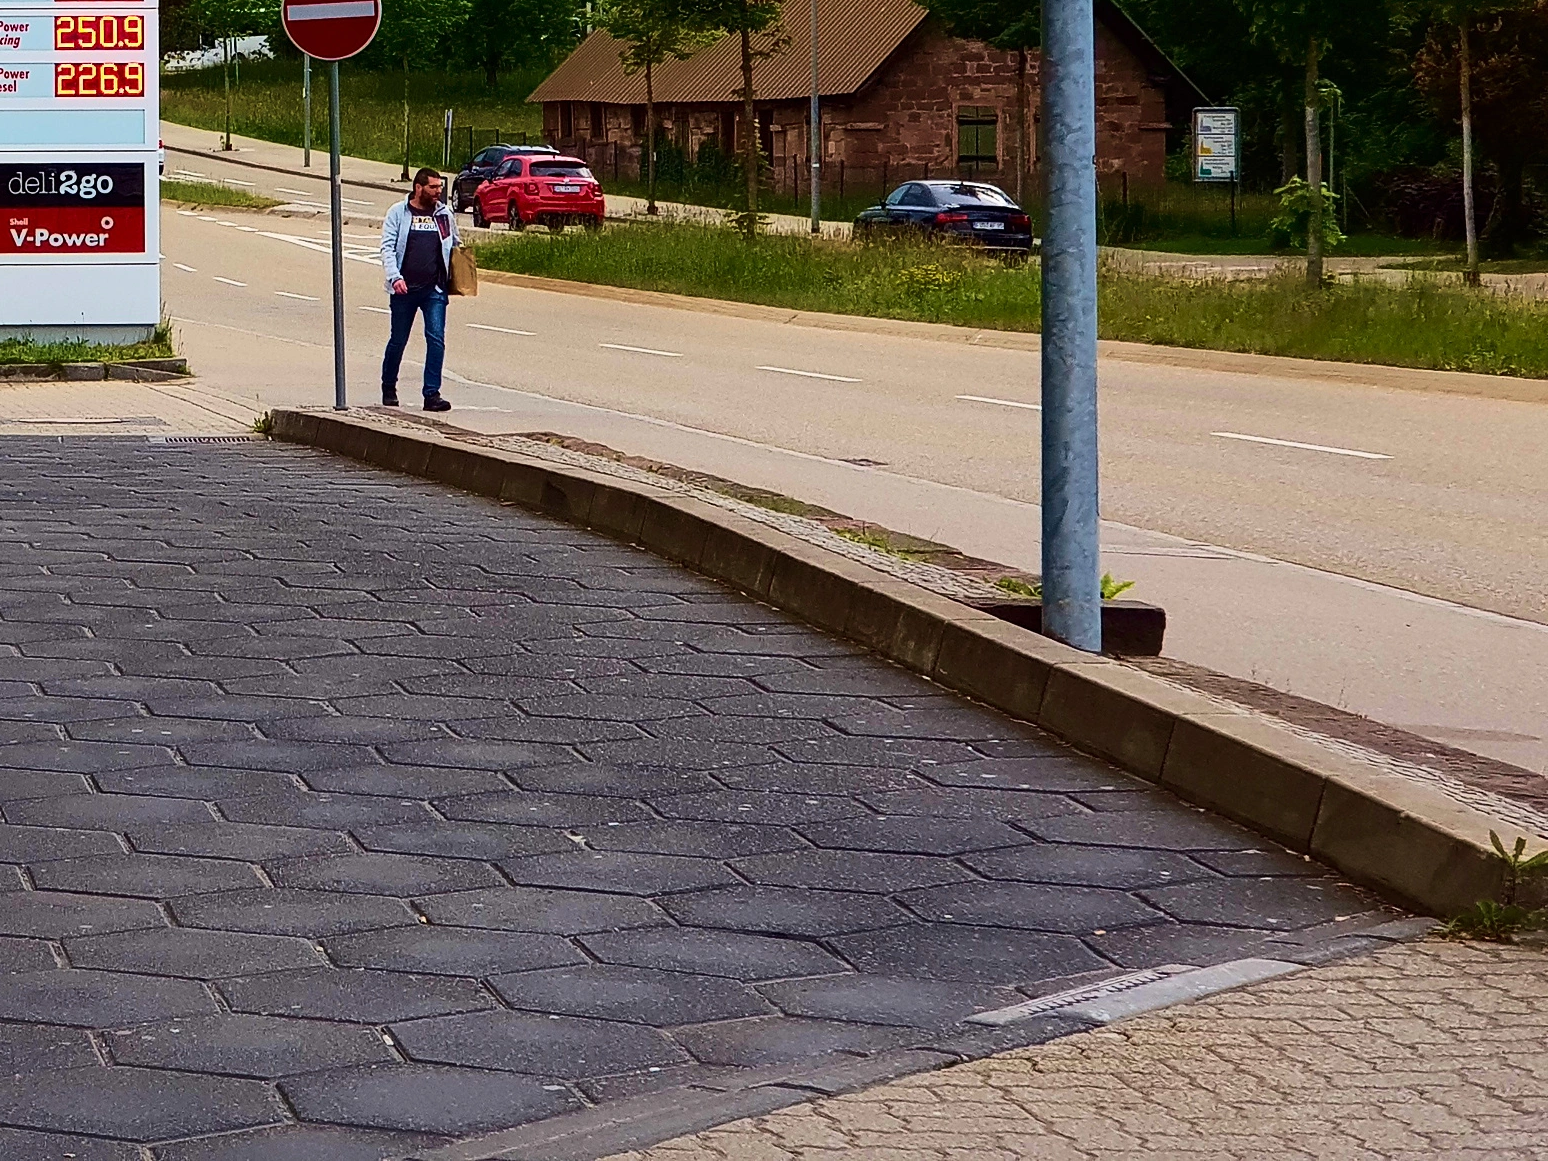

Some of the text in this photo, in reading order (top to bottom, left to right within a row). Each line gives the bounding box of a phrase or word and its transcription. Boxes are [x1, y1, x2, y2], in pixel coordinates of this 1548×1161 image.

[56, 15, 143, 48] 250.9
[57, 62, 143, 95] 226.9
[8, 170, 114, 199] deli2go
[9, 217, 29, 226] Shell
[10, 228, 109, 247] V-Power
